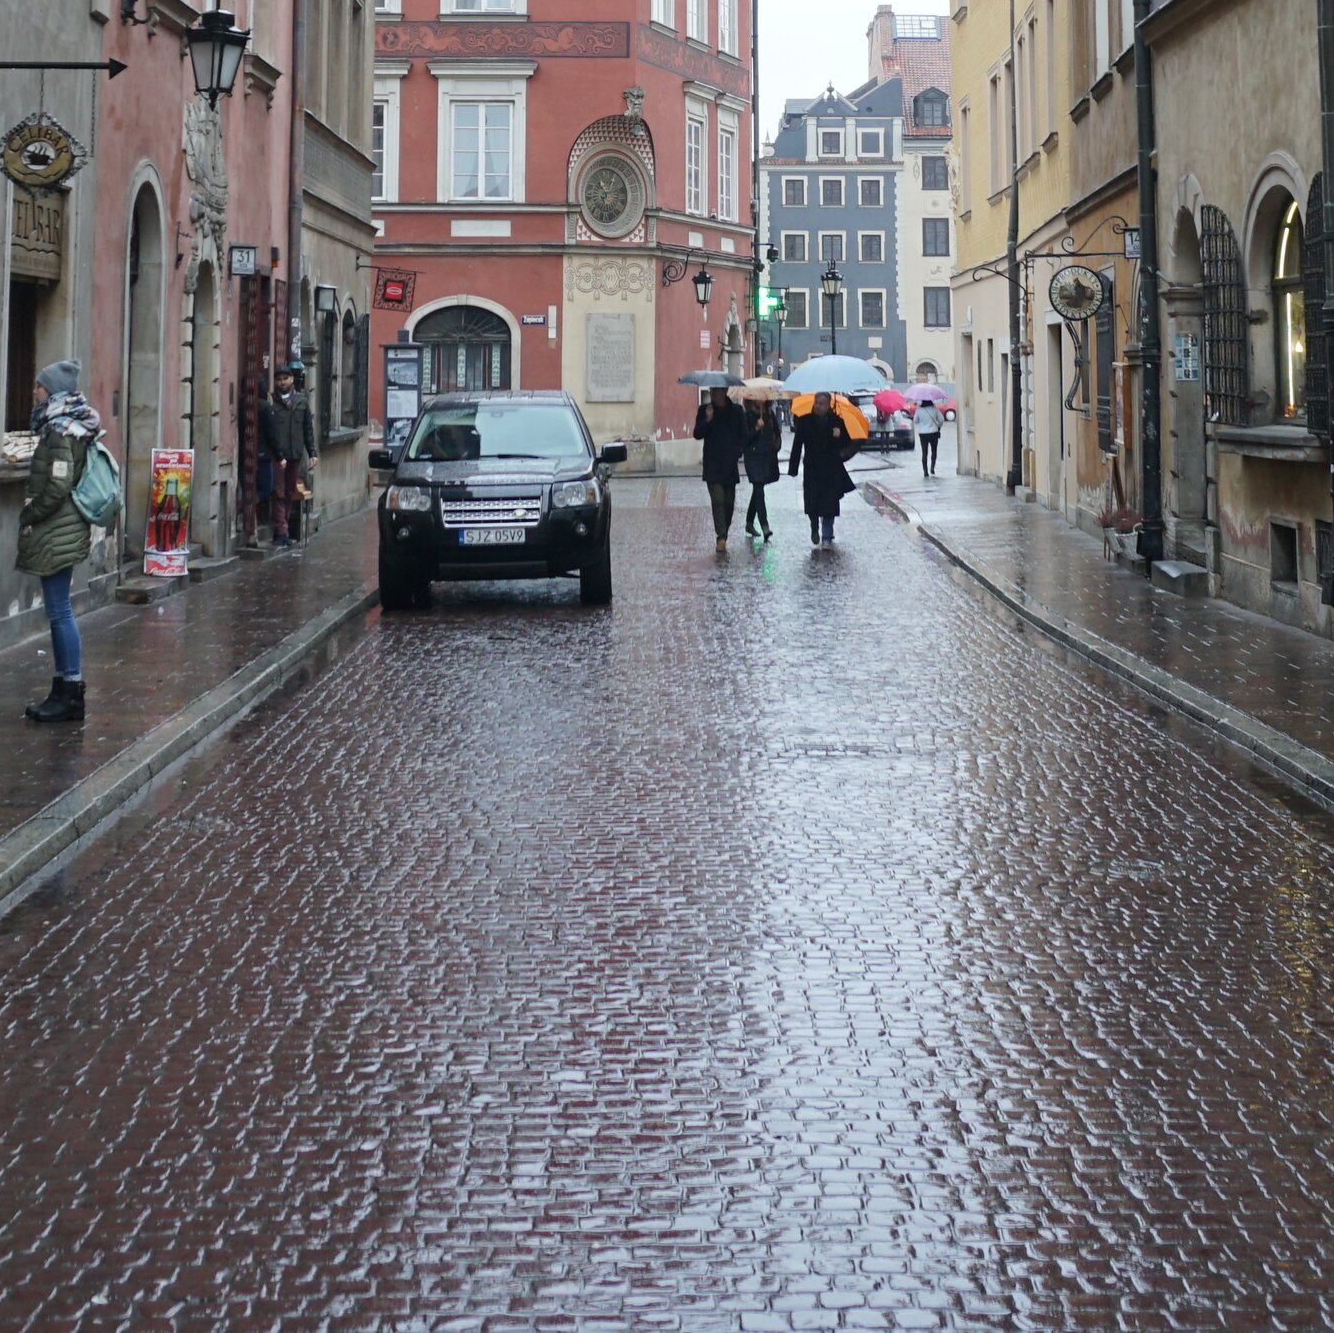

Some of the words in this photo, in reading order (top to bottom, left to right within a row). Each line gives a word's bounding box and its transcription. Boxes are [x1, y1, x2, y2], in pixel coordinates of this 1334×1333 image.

[8, 128, 69, 159] CELIBAR
[11, 196, 61, 245] ELIBAR
[237, 250, 250, 263] 31
[1056, 267, 1098, 284] PRODUKTY
[466, 532, 492, 543] SJZ
